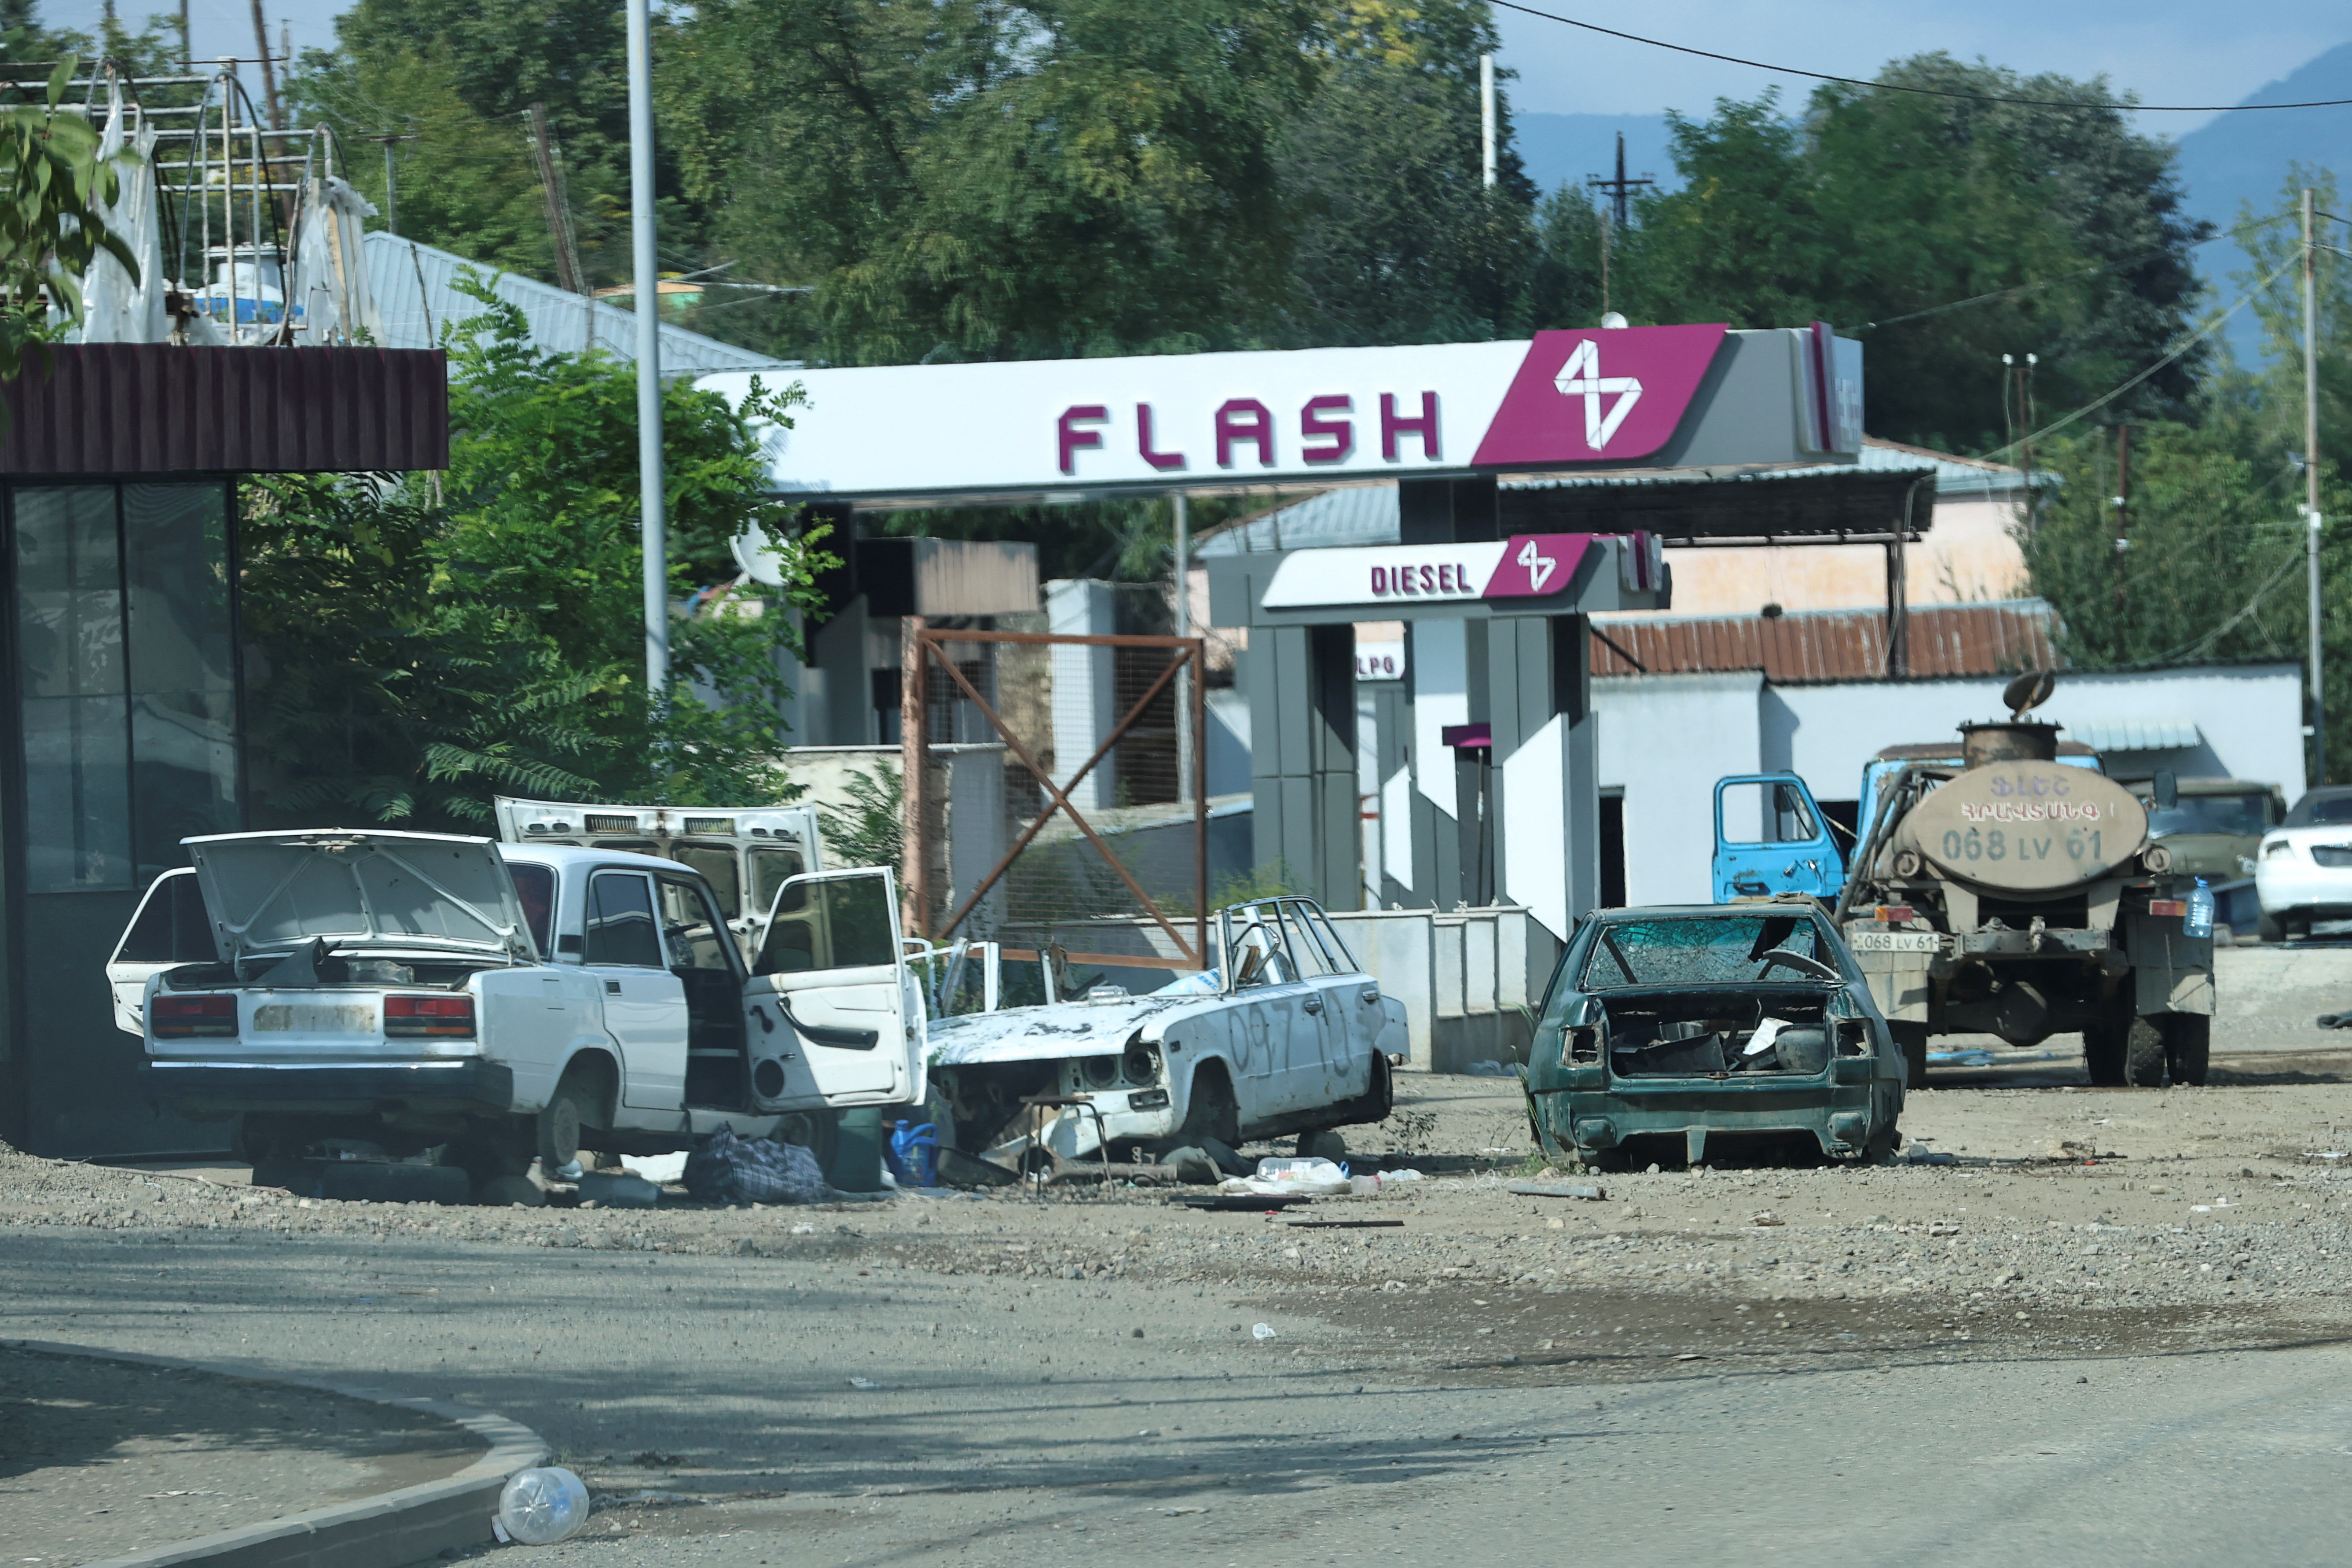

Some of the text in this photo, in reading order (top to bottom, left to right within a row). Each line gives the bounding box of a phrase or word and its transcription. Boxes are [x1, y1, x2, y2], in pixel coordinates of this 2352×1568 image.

[1058, 391, 1439, 471] FLASH
[1371, 564, 1472, 594] DIESEL
[1943, 829, 2101, 860] 068 LV 61
[1864, 935, 1933, 949] 068 LV 61
